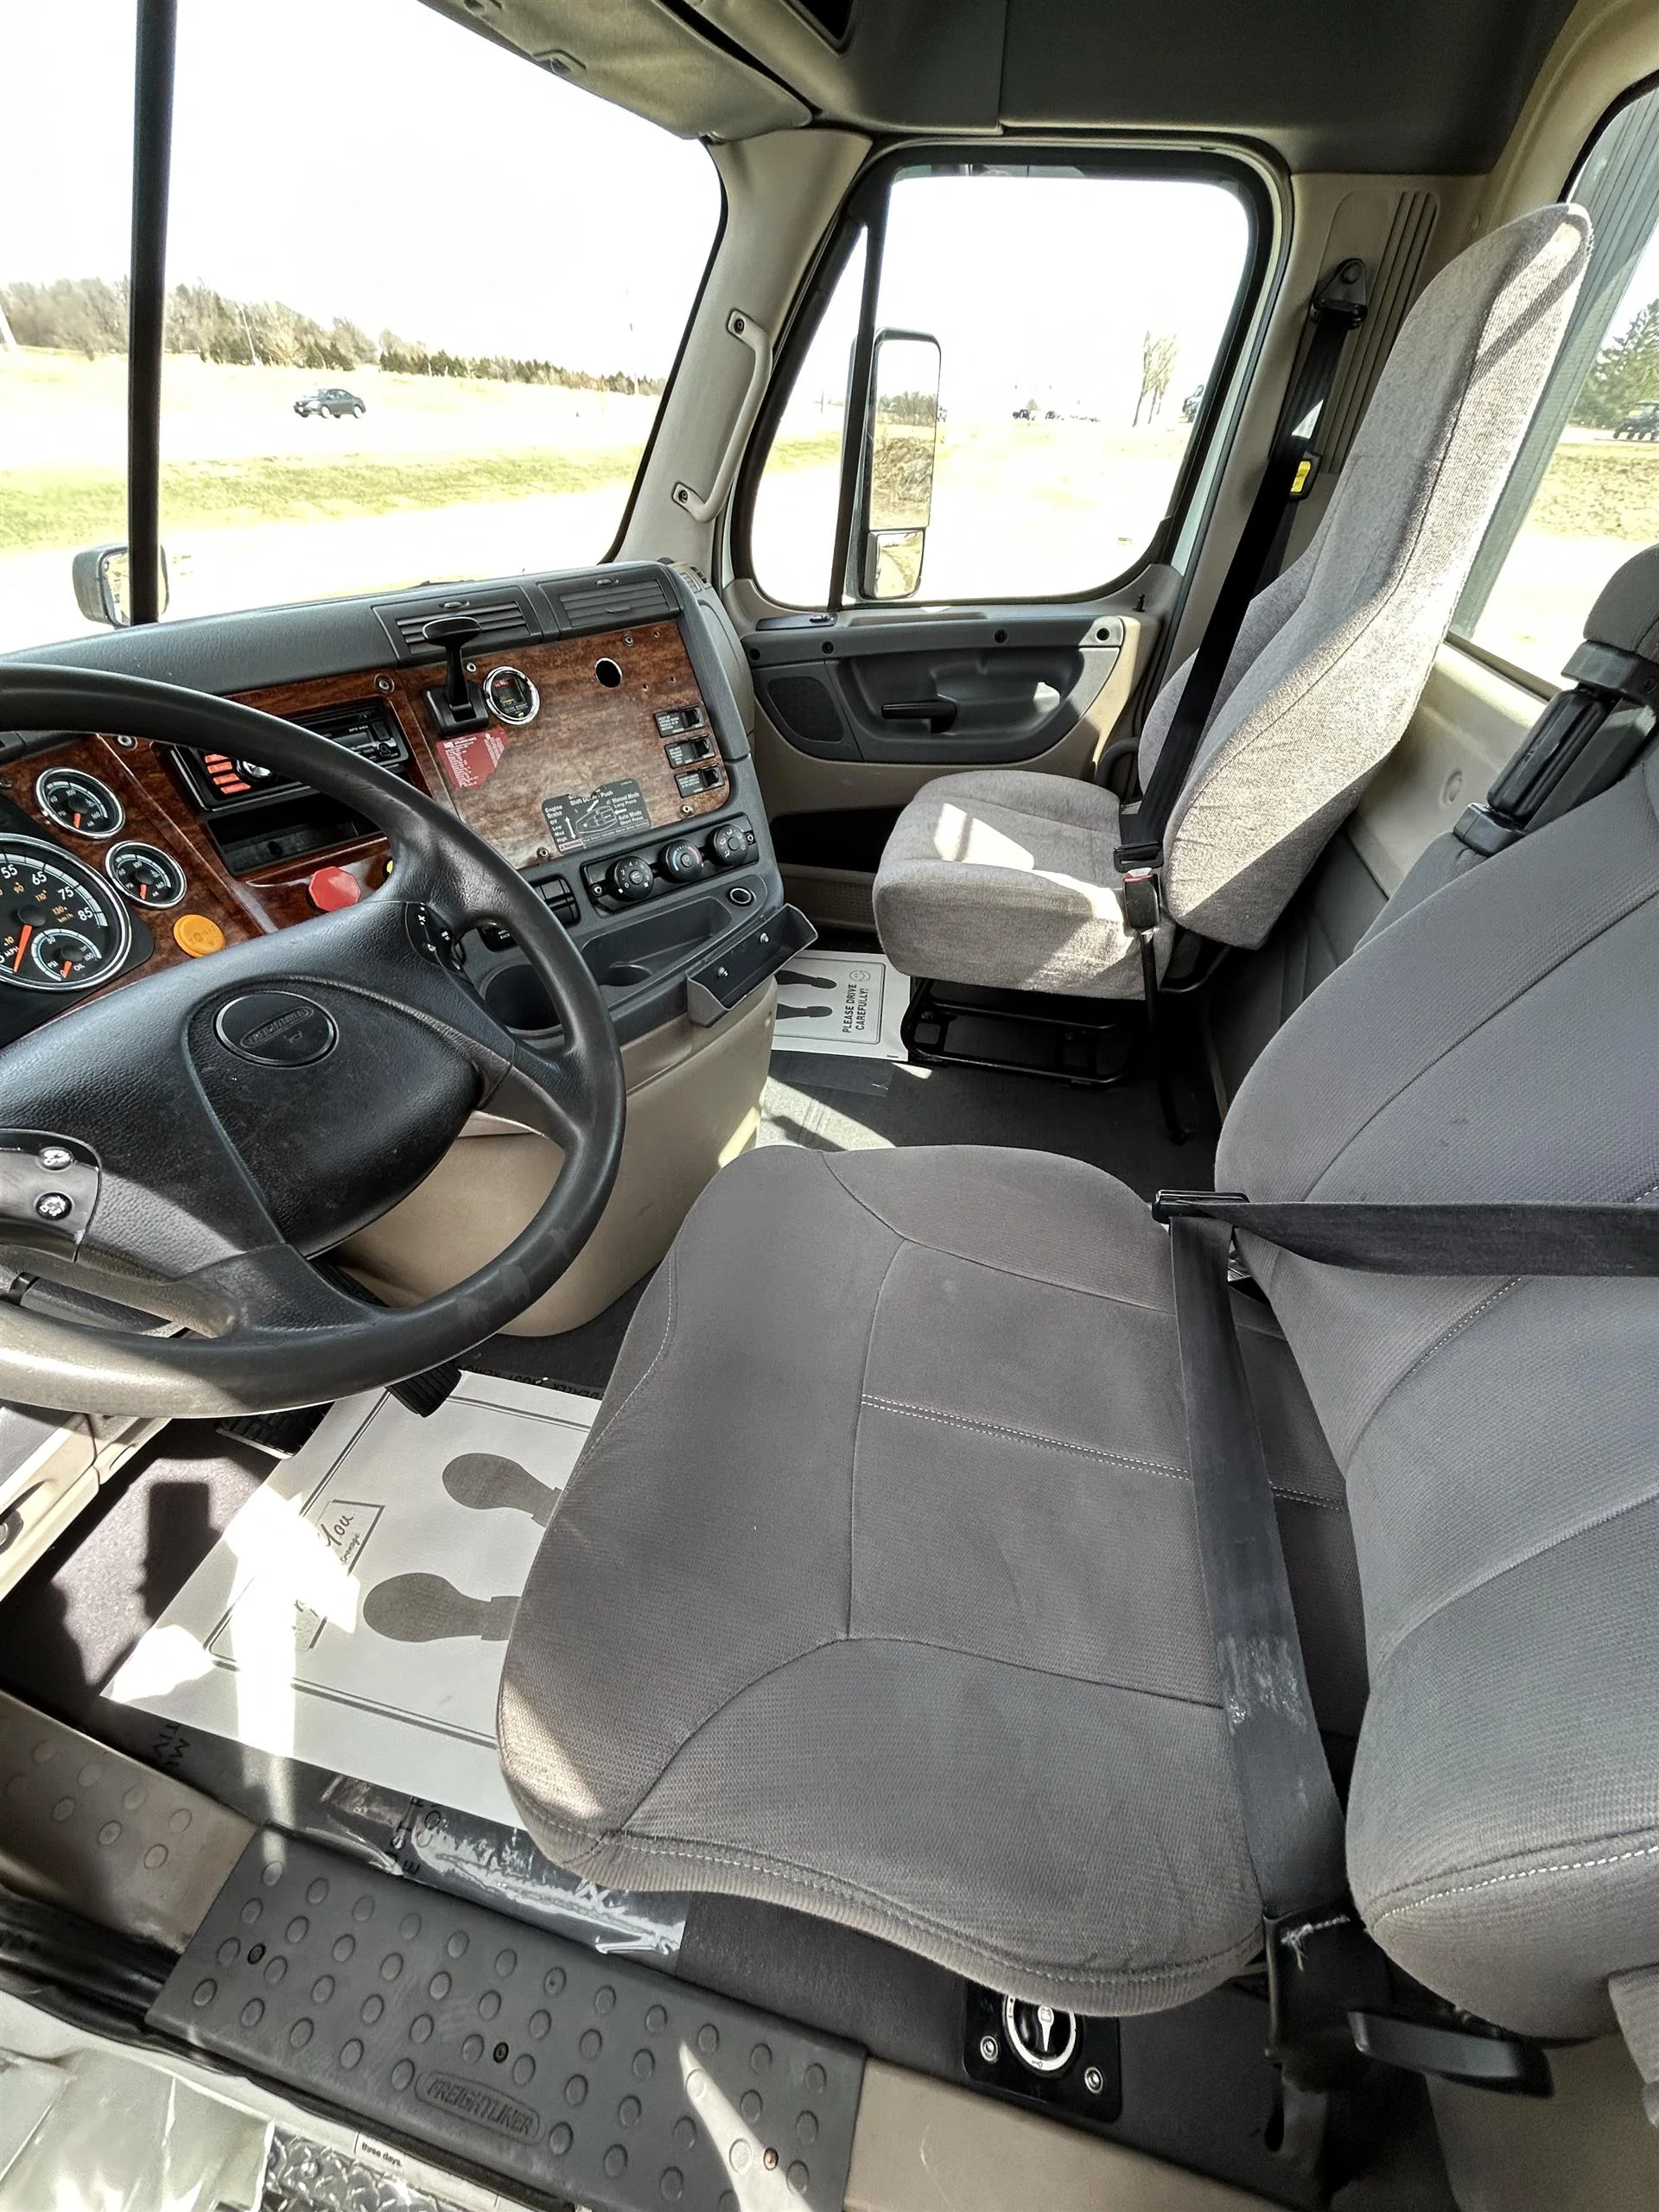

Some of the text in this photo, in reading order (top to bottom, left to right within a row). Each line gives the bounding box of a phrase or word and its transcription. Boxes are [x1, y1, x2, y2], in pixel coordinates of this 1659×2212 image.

[1, 864, 17, 879] 55
[32, 871, 47, 885] 65
[58, 887, 74, 900] 75
[78, 907, 92, 920] 85
[842, 983, 857, 1033] PLEASE DRIVE
[855, 988, 869, 1031] CAREFULLY!
[428, 2079, 534, 2136] FREIGHTLINER
[361, 2142, 381, 2158] three
